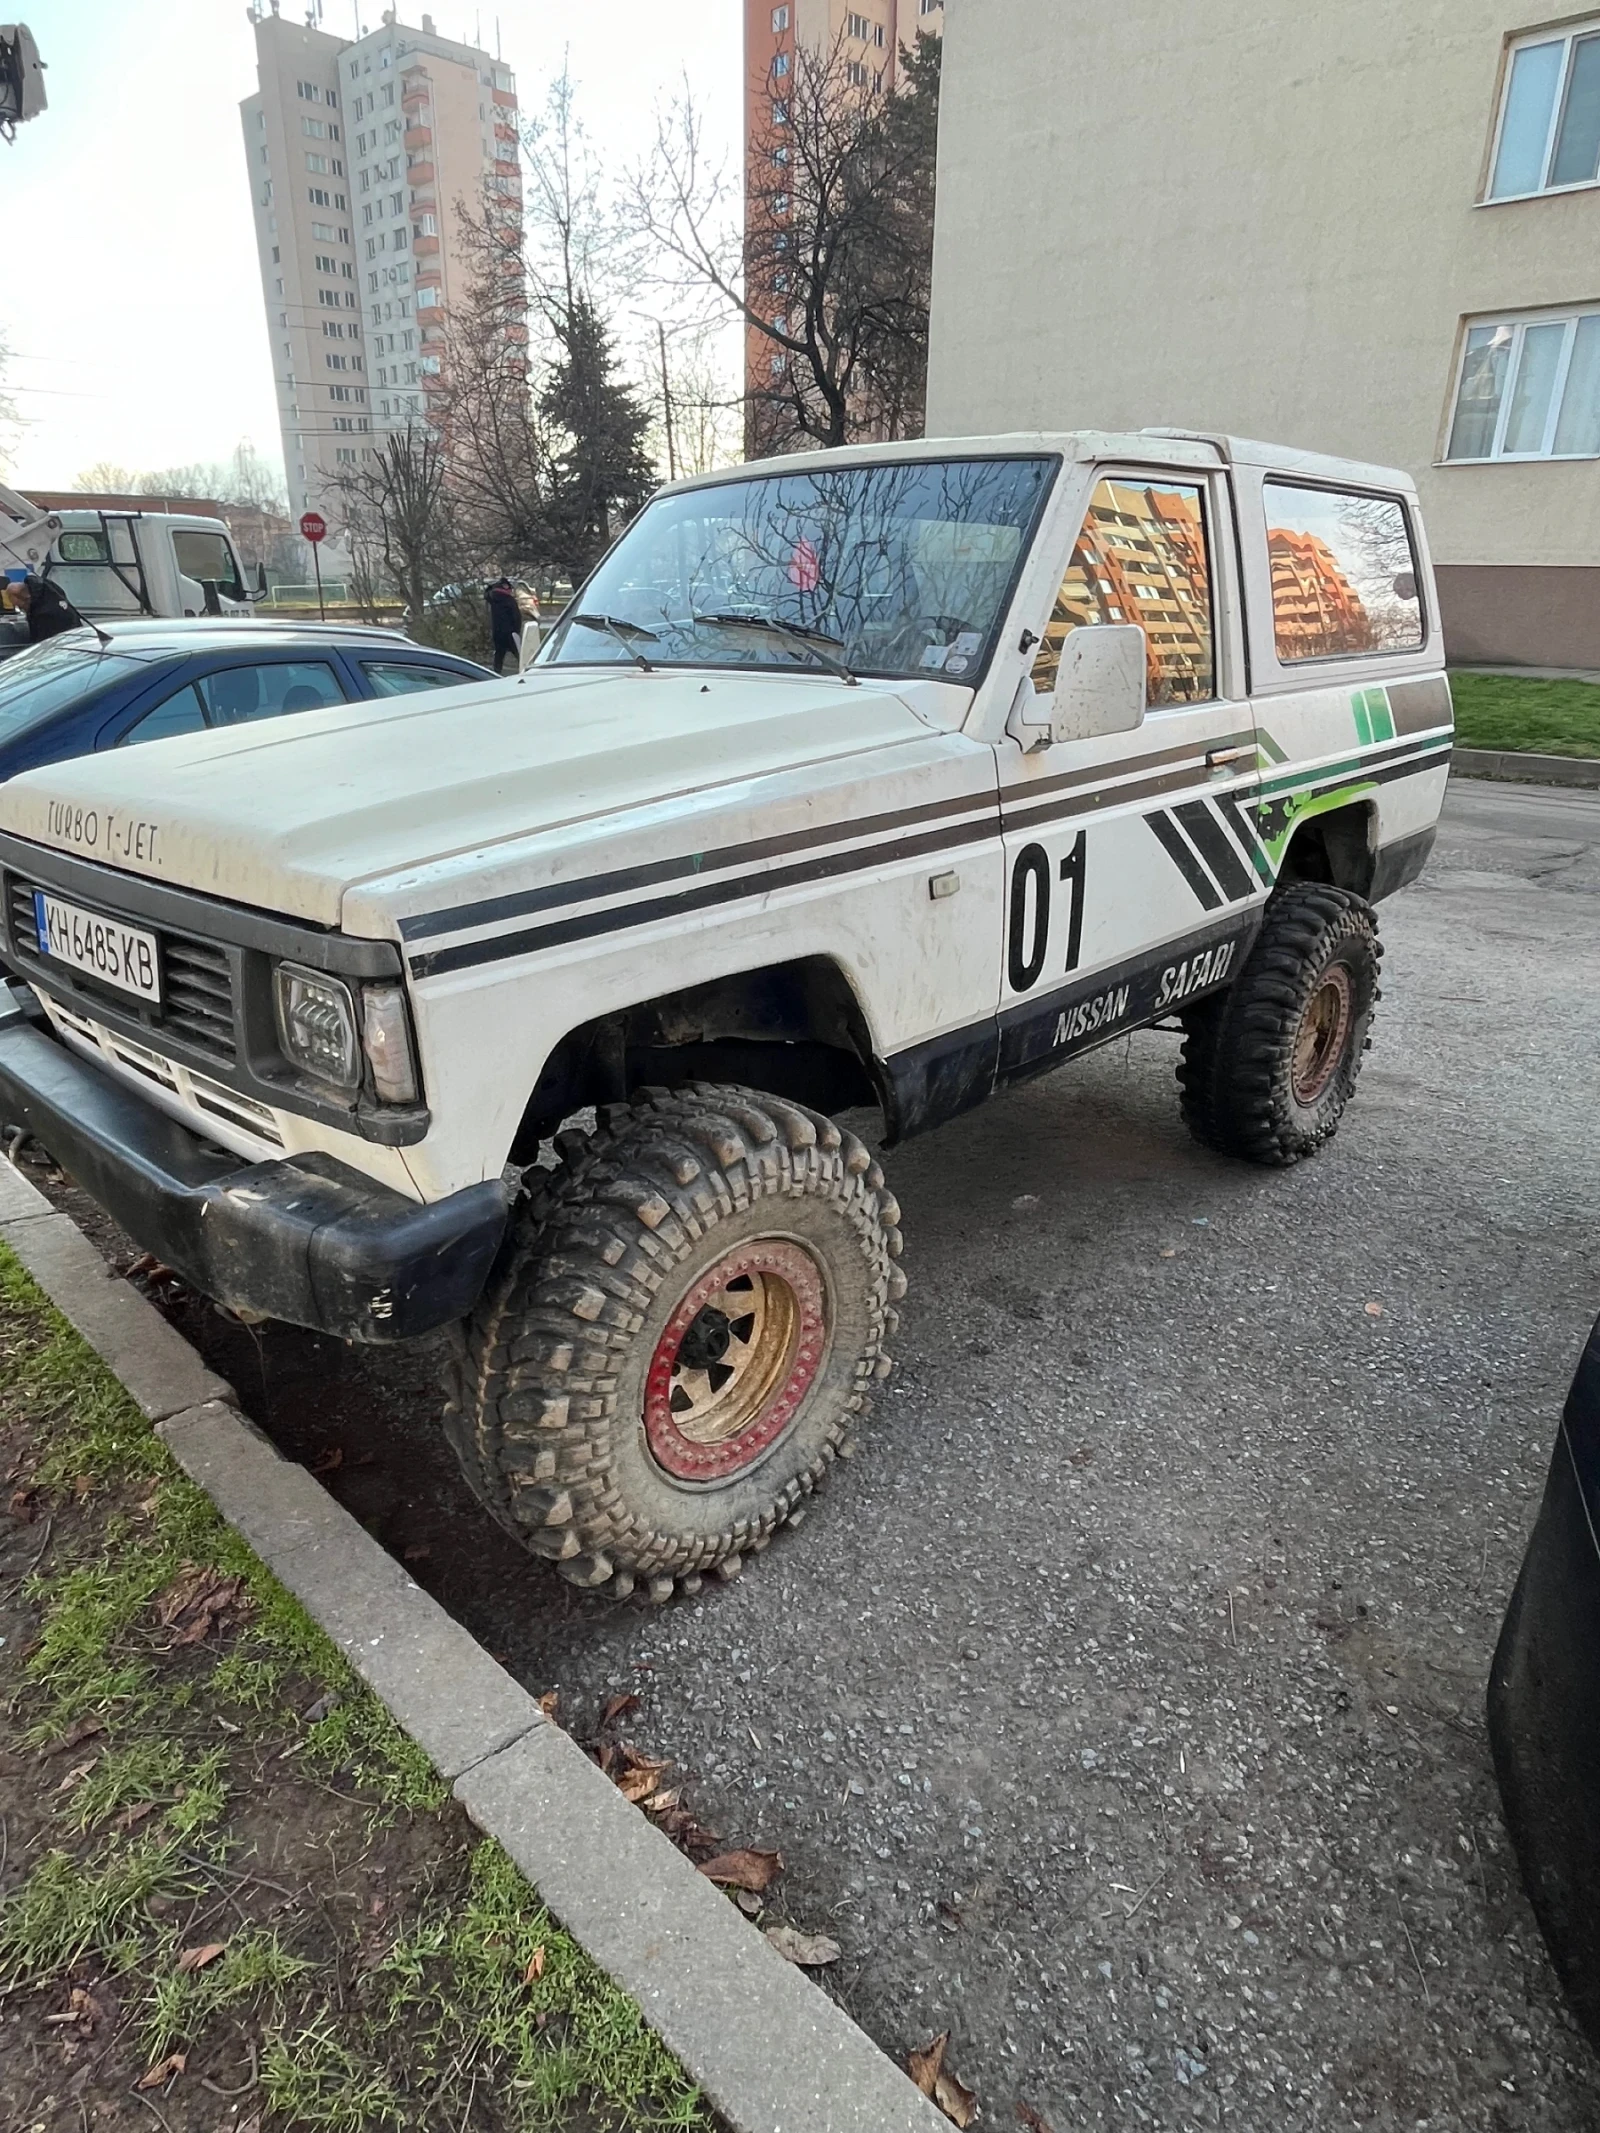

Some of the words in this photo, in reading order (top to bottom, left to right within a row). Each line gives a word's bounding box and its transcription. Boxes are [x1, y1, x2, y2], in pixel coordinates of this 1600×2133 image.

[303, 522, 324, 533] STOP
[48, 801, 98, 846] TURBO
[1008, 829, 1087, 993] 01
[73, 915, 119, 977] 6485
[1052, 984, 1130, 1048] NISSAN
[1154, 940, 1236, 1009] SAFARI
